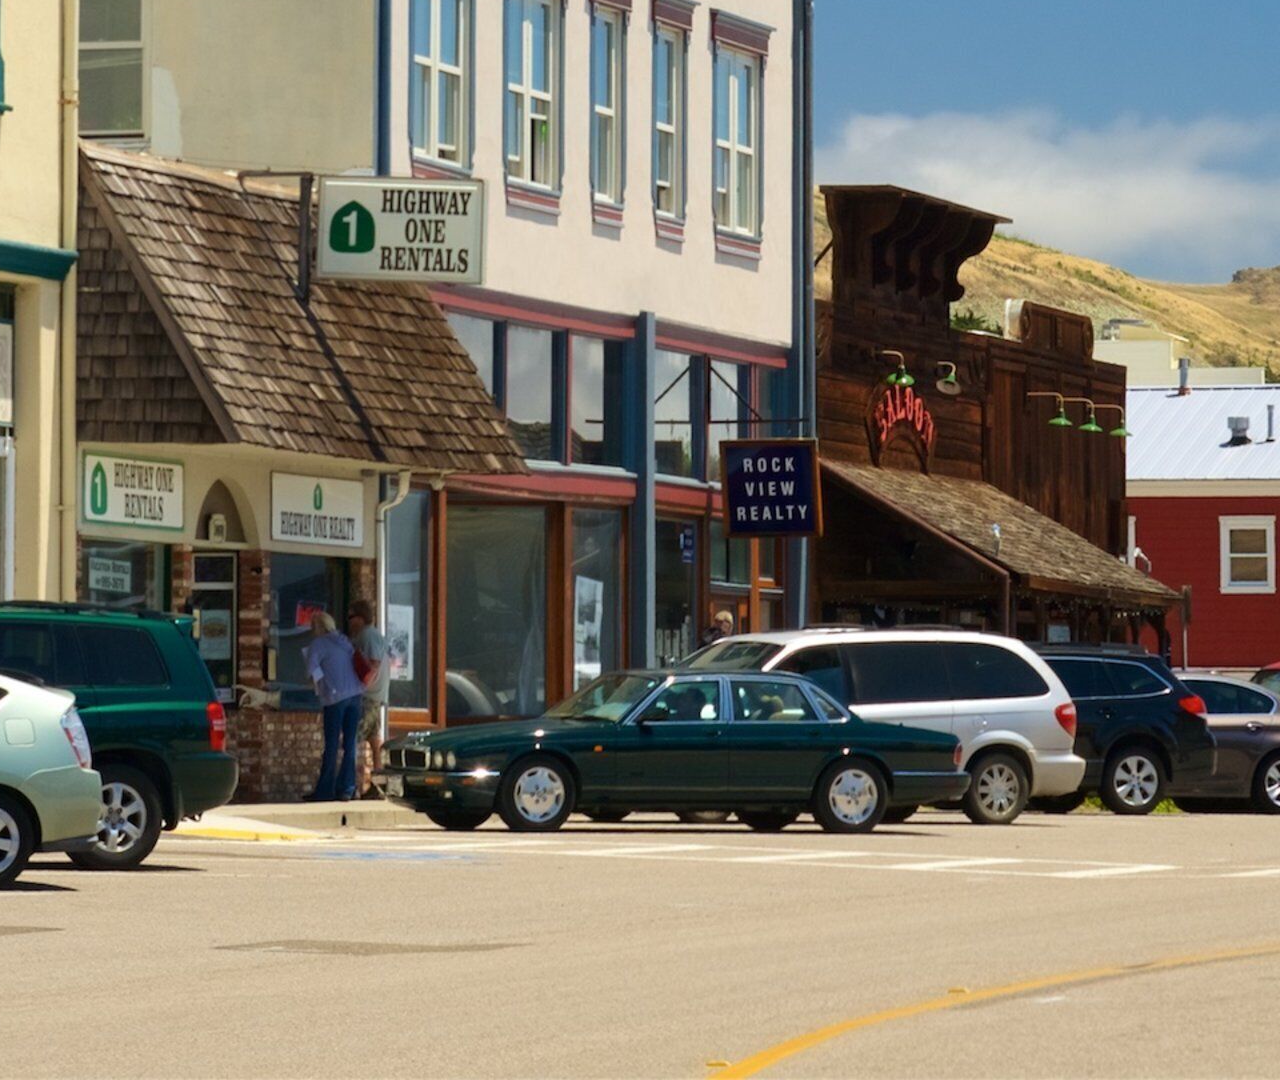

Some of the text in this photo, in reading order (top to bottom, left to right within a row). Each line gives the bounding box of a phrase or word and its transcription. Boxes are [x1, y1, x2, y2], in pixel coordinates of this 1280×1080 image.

[381, 189, 472, 217] HIGHWAY
[342, 210, 358, 248] 1
[404, 218, 446, 244] ONE
[379, 246, 469, 274] RENTALS
[875, 384, 934, 446] SALOON
[114, 462, 175, 493] HIGHWAY ONE
[742, 456, 795, 473] ROCK
[94, 471, 102, 509] 1
[744, 480, 795, 497] VIEW
[124, 493, 164, 522] RENTALS
[736, 504, 808, 521] REALTY
[280, 511, 355, 541] HIGHWAY ONE REALTY
